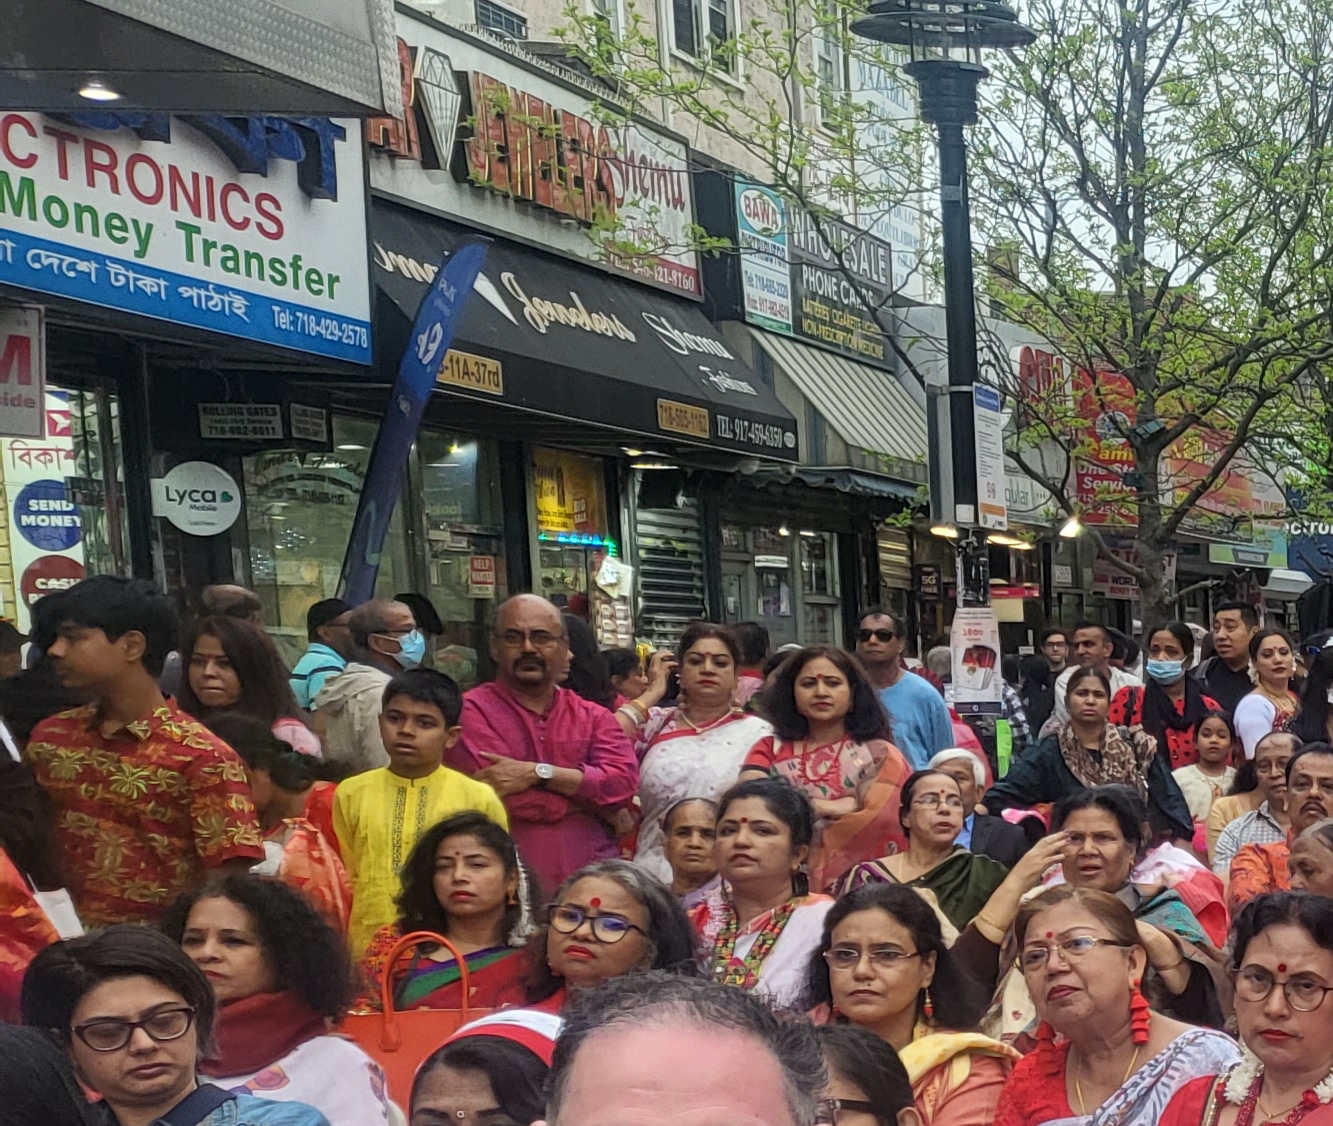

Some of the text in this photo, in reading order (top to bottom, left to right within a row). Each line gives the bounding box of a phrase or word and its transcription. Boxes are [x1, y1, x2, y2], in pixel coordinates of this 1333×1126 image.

[744, 195, 779, 228] BAWA
[0, 170, 153, 259] Money
[175, 220, 340, 300] Transfer
[790, 205, 887, 285] WHOLESALE
[26, 248, 100, 284] দেশে
[105, 259, 169, 301] টাকা
[177, 283, 251, 323] পাঠাই
[802, 264, 838, 300] PHONE
[271, 306, 368, 348] Tel: 718-429-2578
[28, 499, 75, 511] SEND
[165, 485, 217, 505] Lyca
[21, 515, 81, 528] MONEY
[473, 558, 490, 570] HELP
[921, 575, 936, 585] 5G
